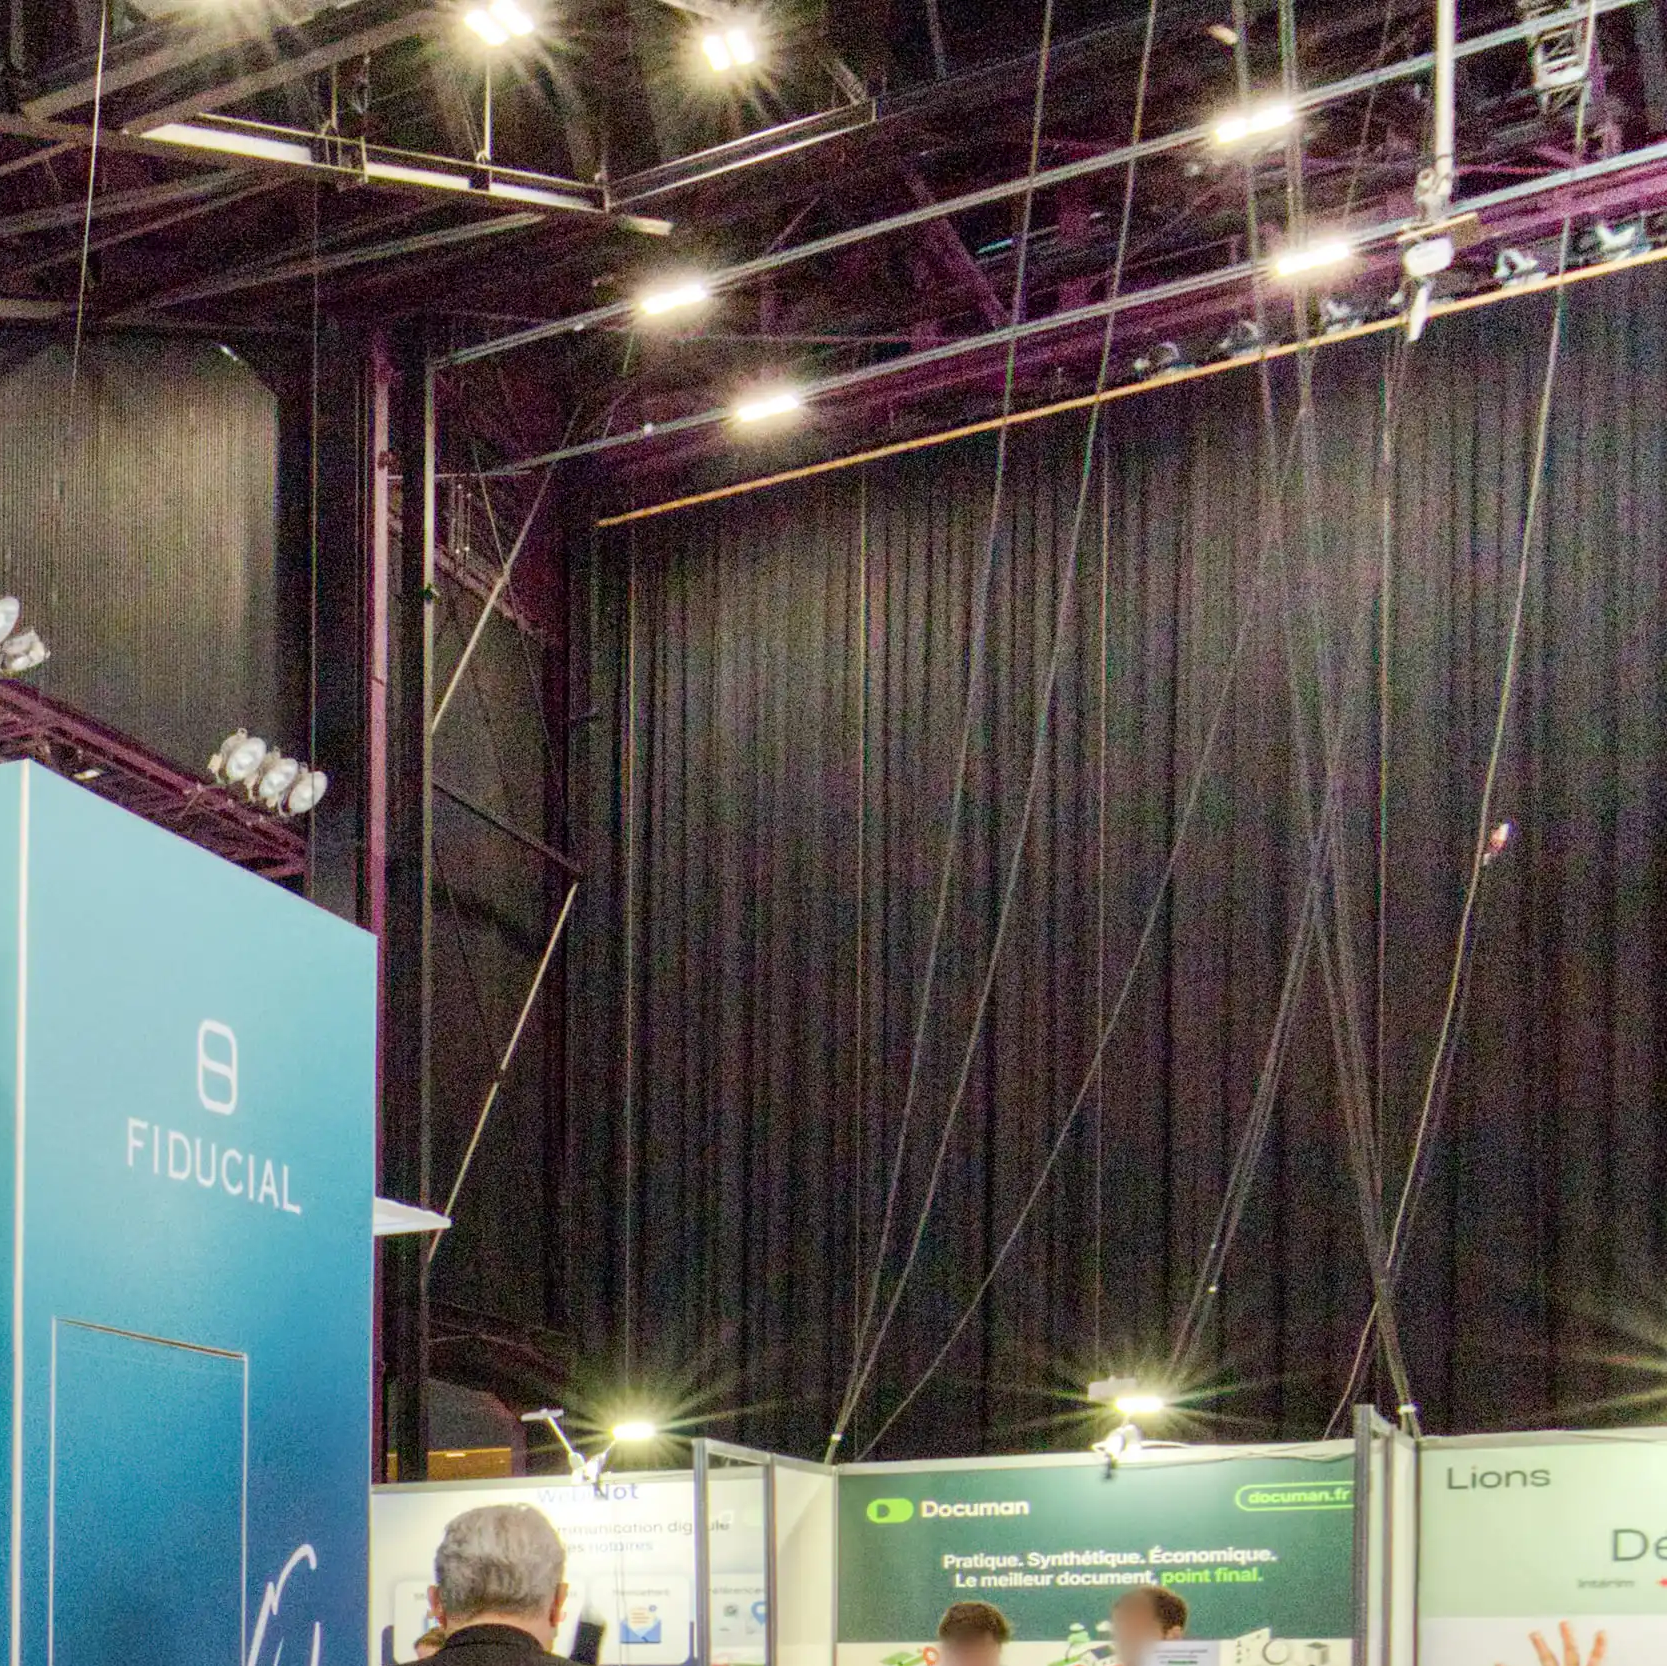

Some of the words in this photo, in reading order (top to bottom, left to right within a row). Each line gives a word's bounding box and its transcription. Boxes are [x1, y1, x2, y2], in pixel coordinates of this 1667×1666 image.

[126, 1116, 302, 1216] FIDUCIAL
[1446, 1465, 1552, 1491] Lions
[1248, 1486, 1352, 1505] documan.fr
[920, 1500, 1030, 1519] Documan
[942, 1552, 1024, 1571] Pratique.
[1027, 1548, 1146, 1570] Synthétique.
[1148, 1545, 1278, 1564] Économique.
[955, 1573, 977, 1588] Le
[980, 1571, 1053, 1588] meilleur
[1056, 1569, 1158, 1588] document,
[1160, 1567, 1210, 1587] point
[1214, 1566, 1264, 1583] final.
